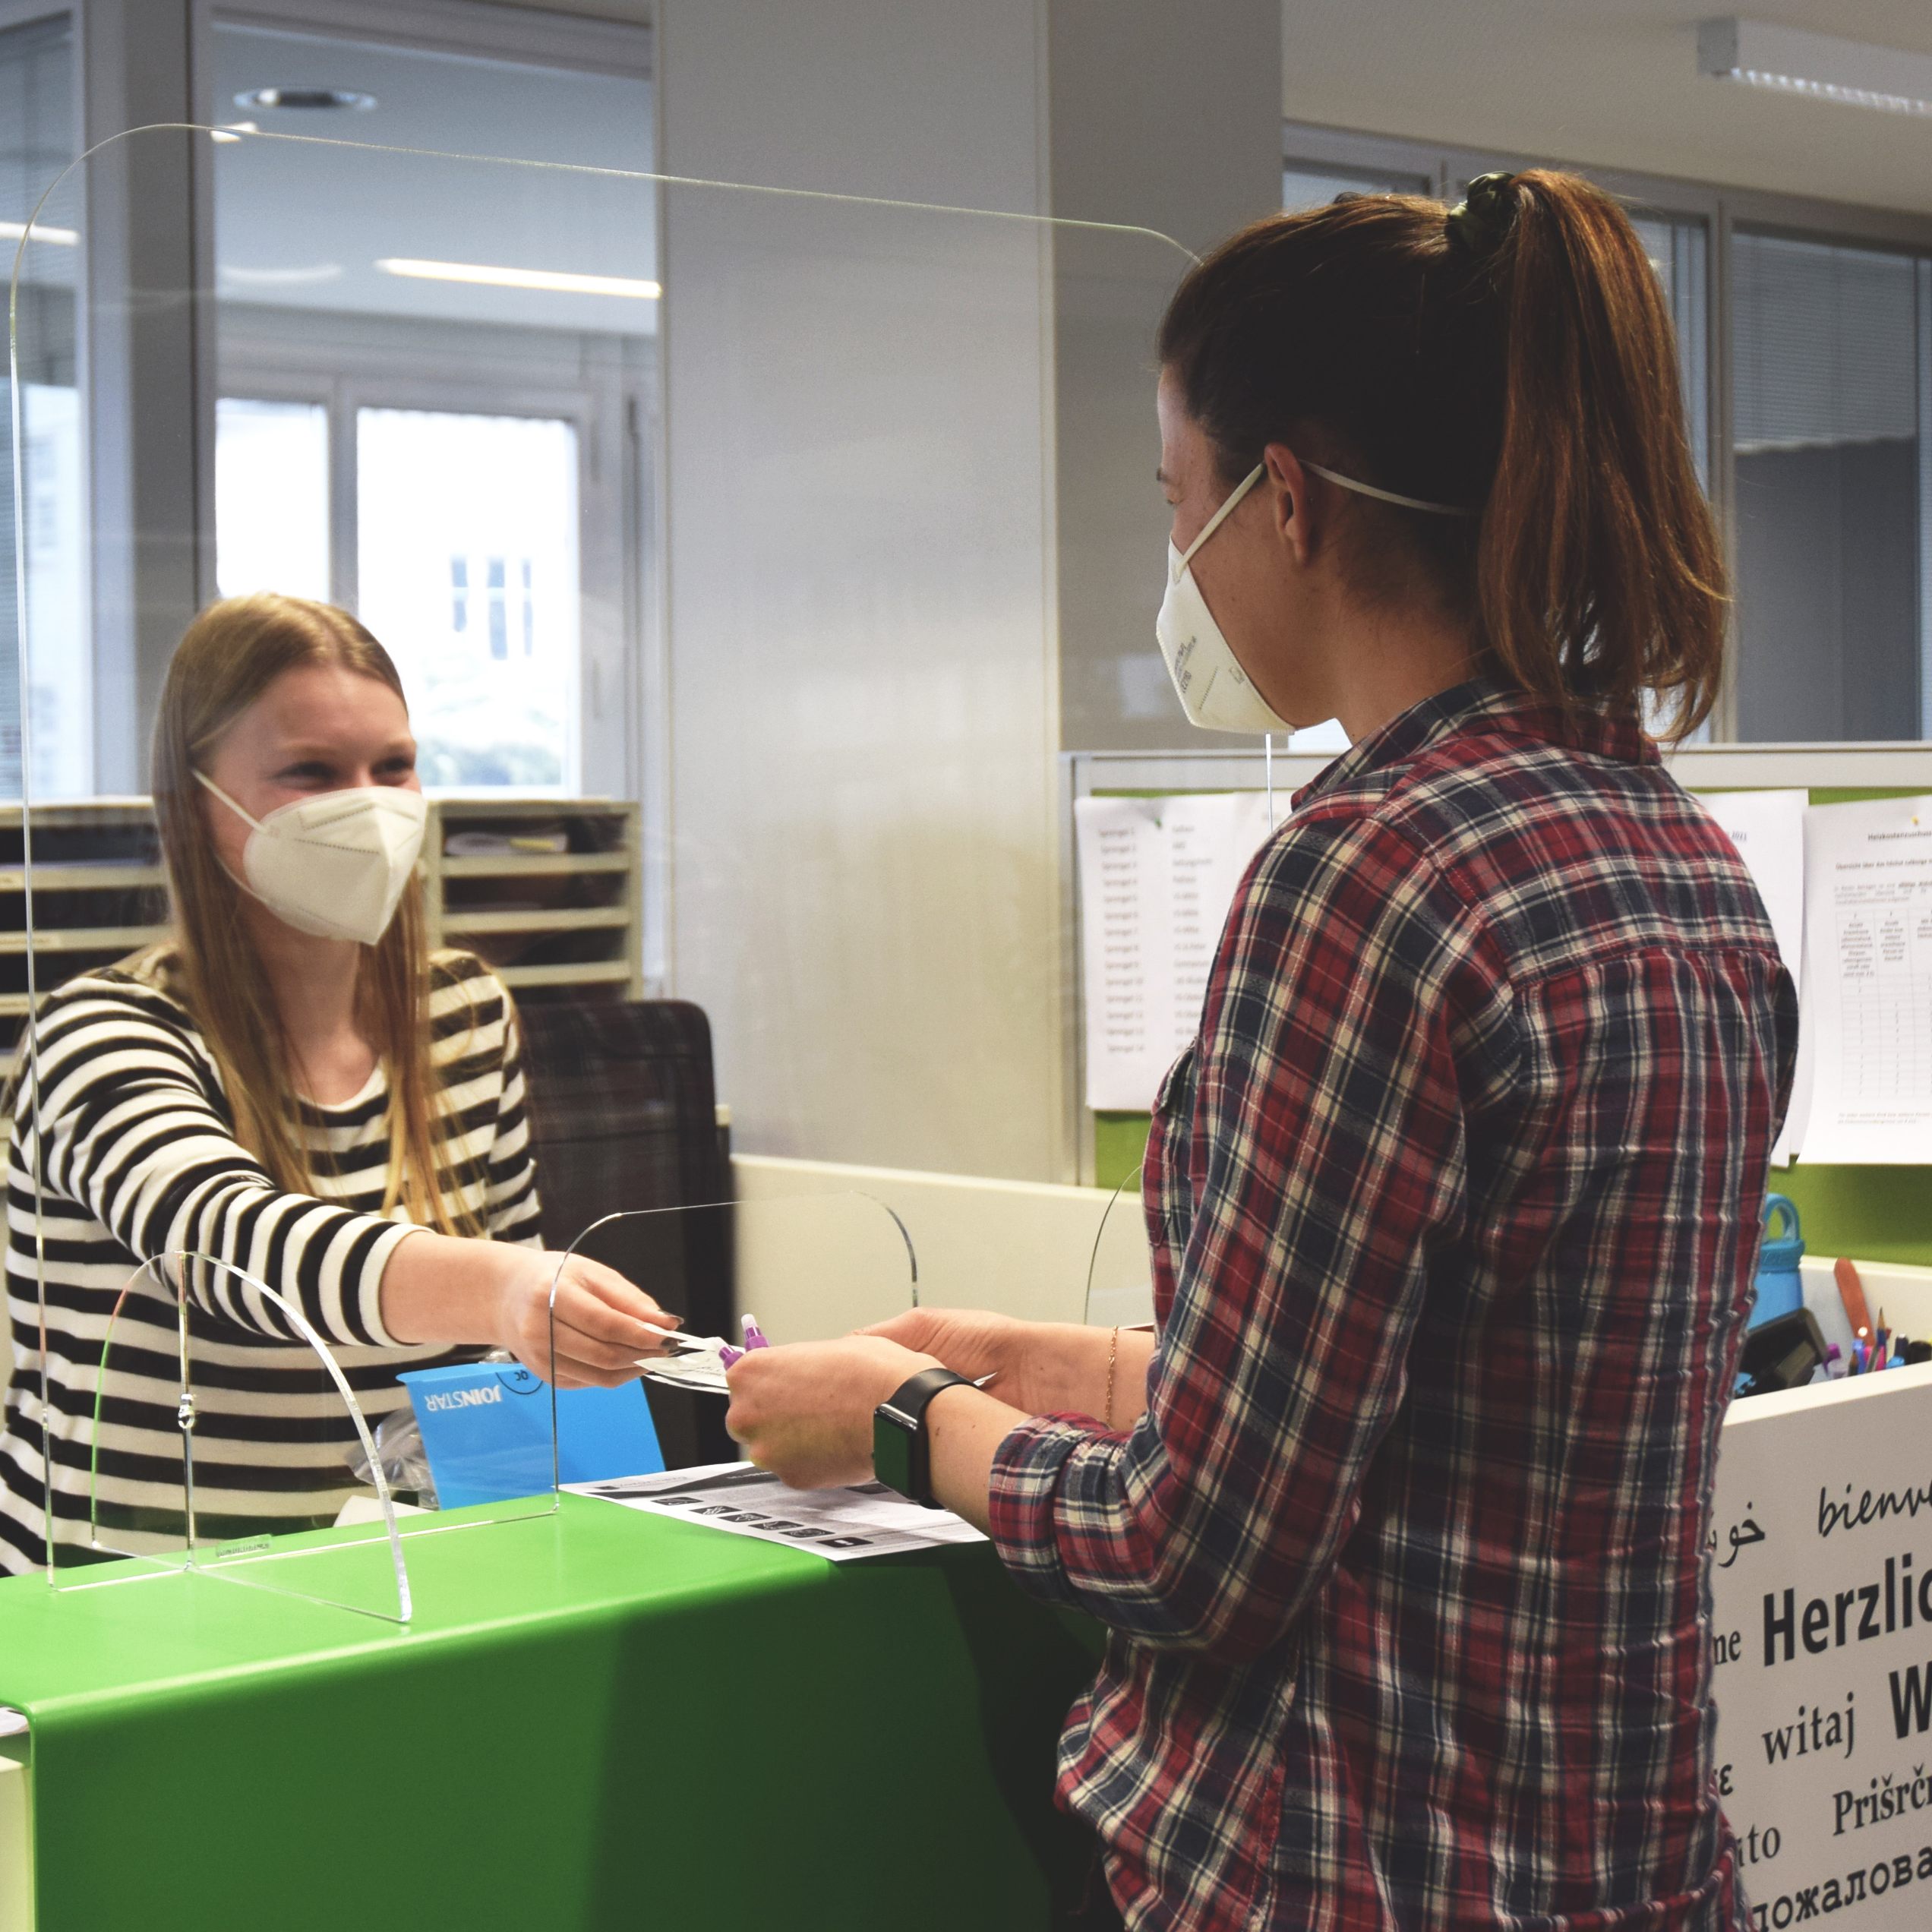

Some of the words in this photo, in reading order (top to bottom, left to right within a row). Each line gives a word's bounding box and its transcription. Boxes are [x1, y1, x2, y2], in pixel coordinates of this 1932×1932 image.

[425, 1386, 501, 1411] JOINSTAR
[1817, 1479, 1932, 1538] bienv
[1761, 1691, 1855, 1765] witaj
[1832, 1763, 1932, 1836] Prišrč
